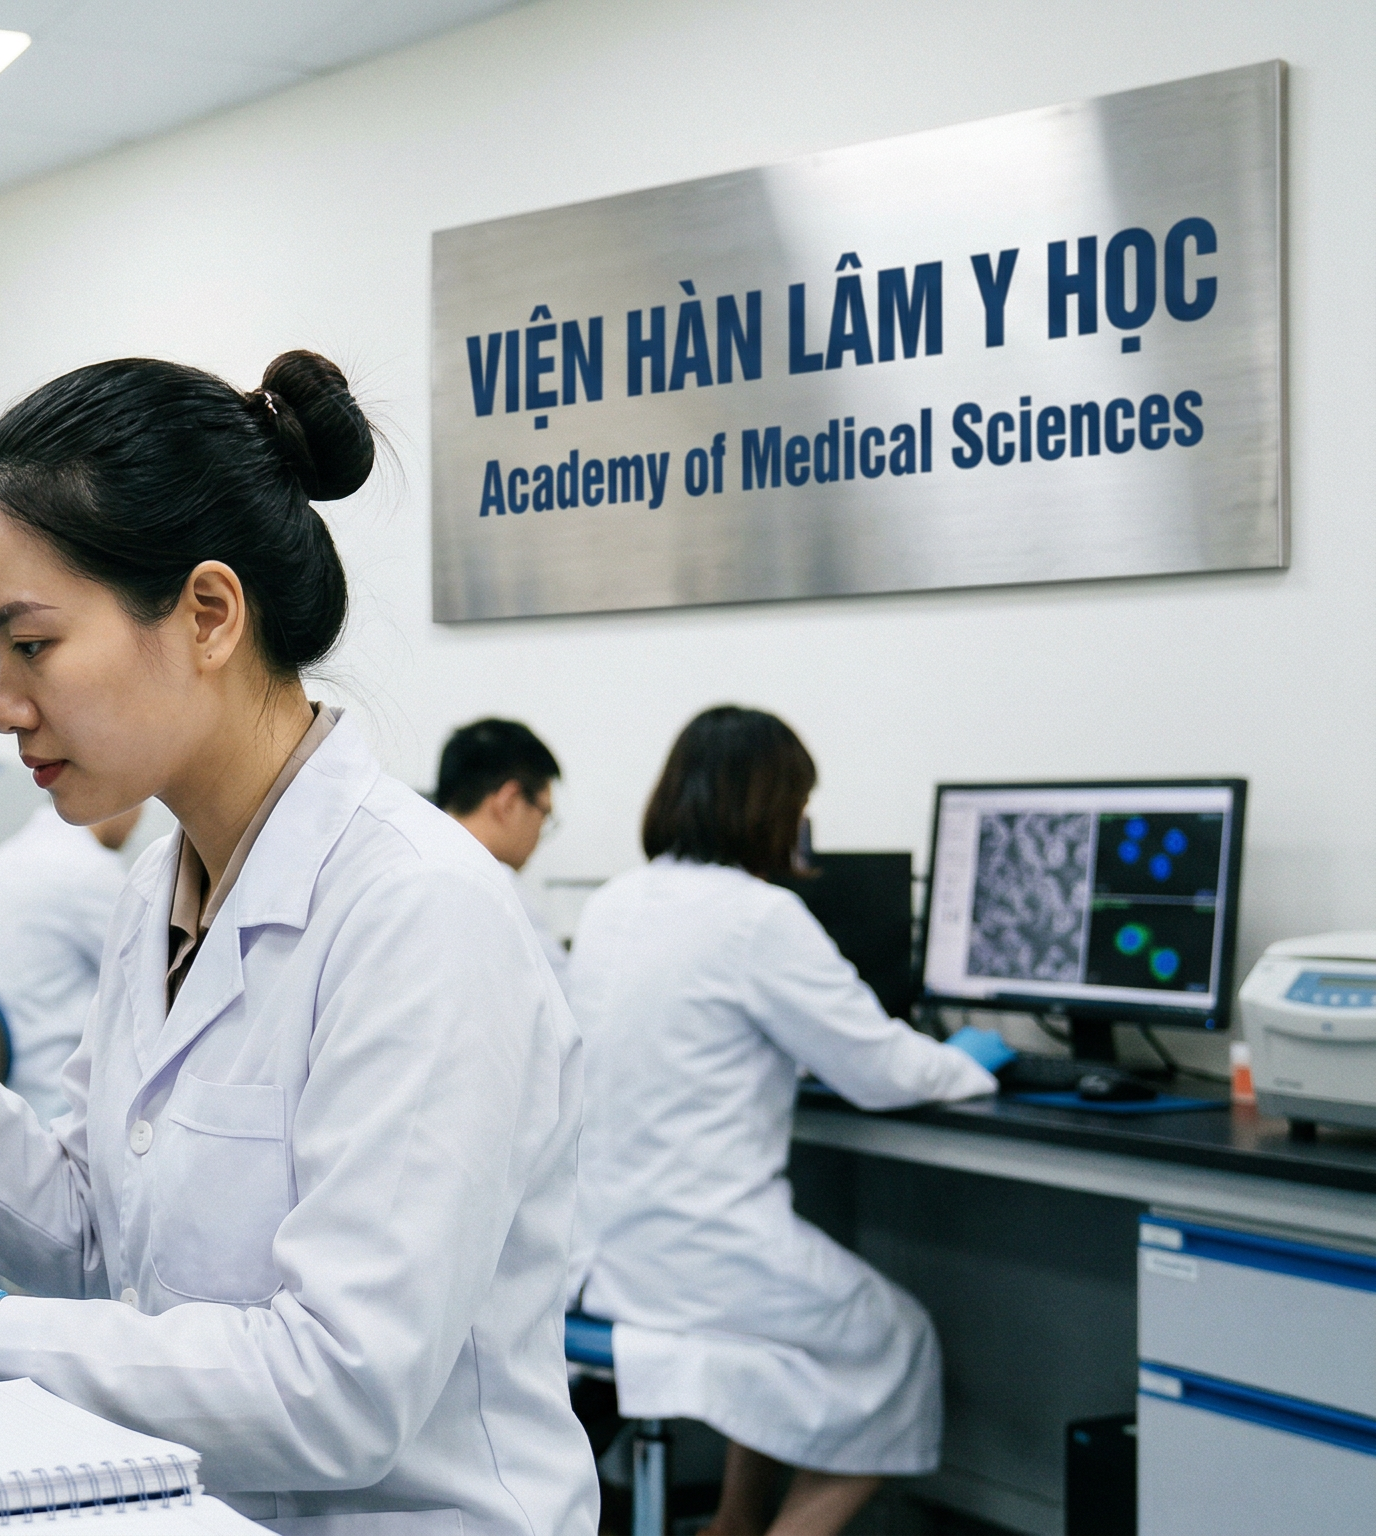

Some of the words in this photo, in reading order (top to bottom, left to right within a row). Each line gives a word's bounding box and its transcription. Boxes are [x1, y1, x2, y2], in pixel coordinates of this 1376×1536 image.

[466, 304, 603, 430] VIỆN
[626, 279, 762, 397] HÀN
[788, 252, 943, 375] LÂM
[970, 248, 1019, 348] Y
[1047, 216, 1218, 354] HỌC
[479, 449, 670, 517] Academy
[684, 432, 726, 497] of
[741, 408, 932, 491] Medical
[951, 389, 1204, 469] Sciences
